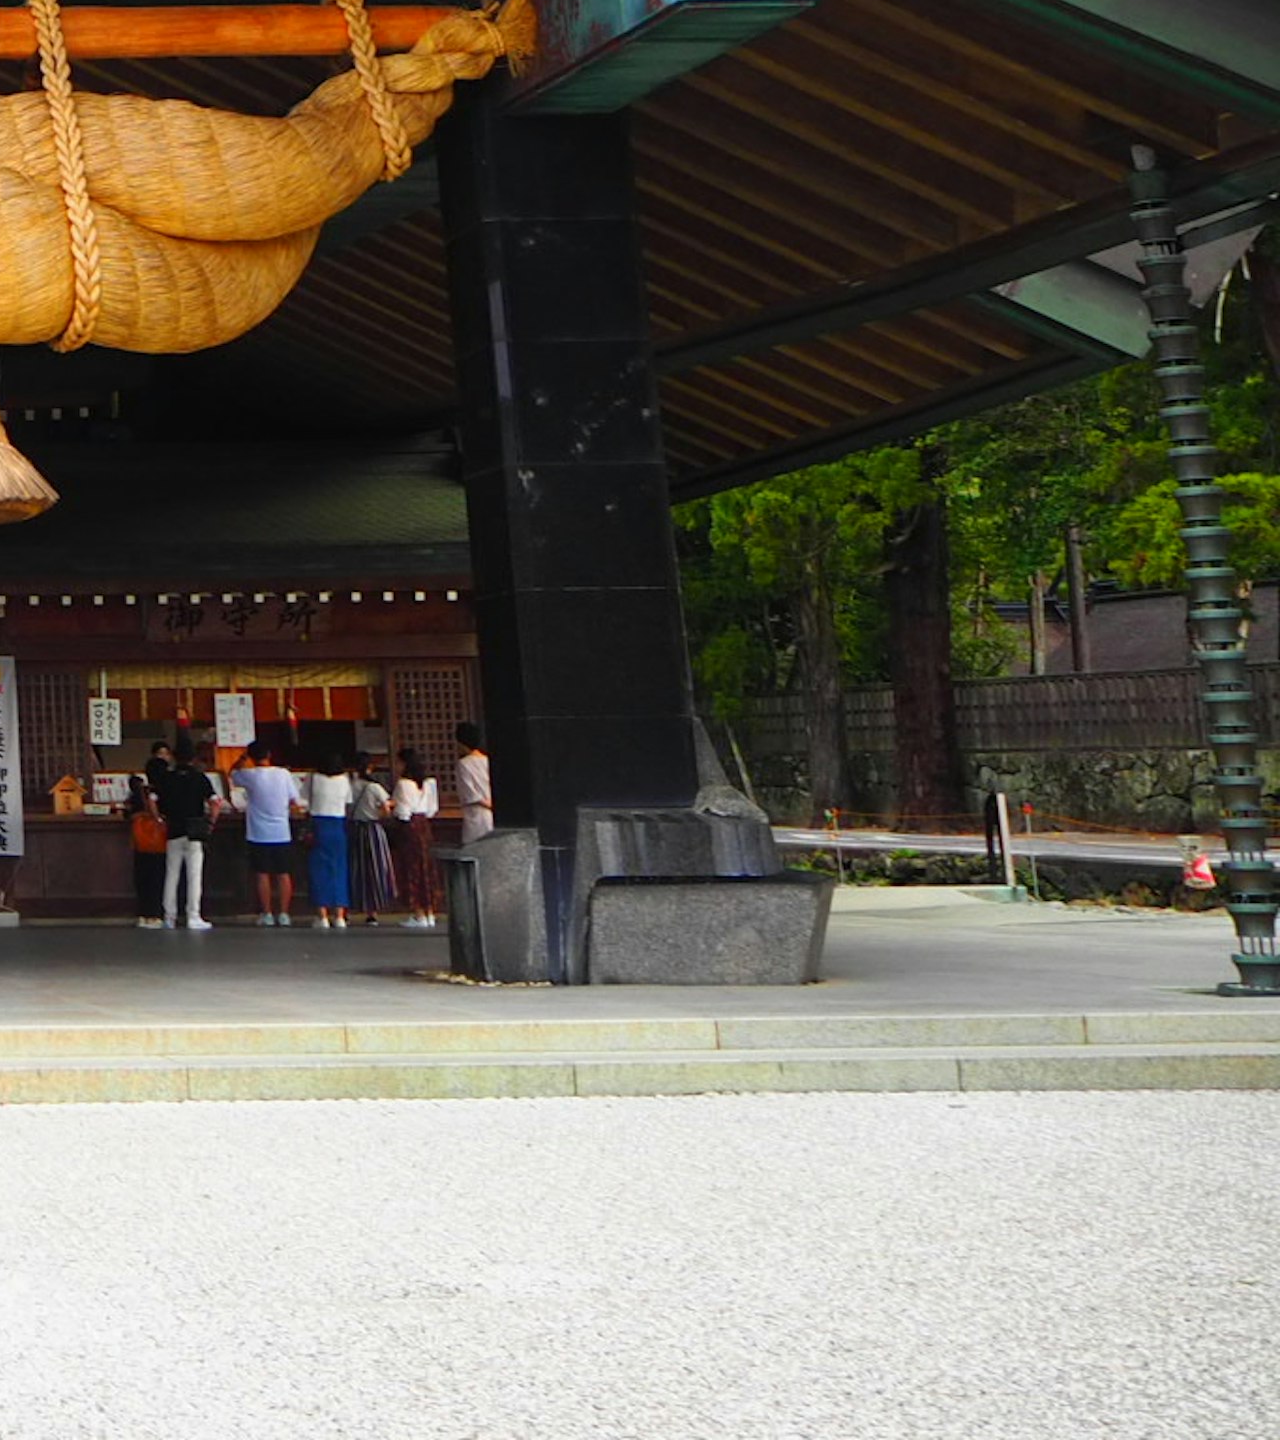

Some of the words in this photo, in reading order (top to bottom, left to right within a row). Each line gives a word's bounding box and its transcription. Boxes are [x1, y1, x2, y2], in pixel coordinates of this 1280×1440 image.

[164, 600, 318, 636] 御守所
[107, 701, 117, 741] おみくじ
